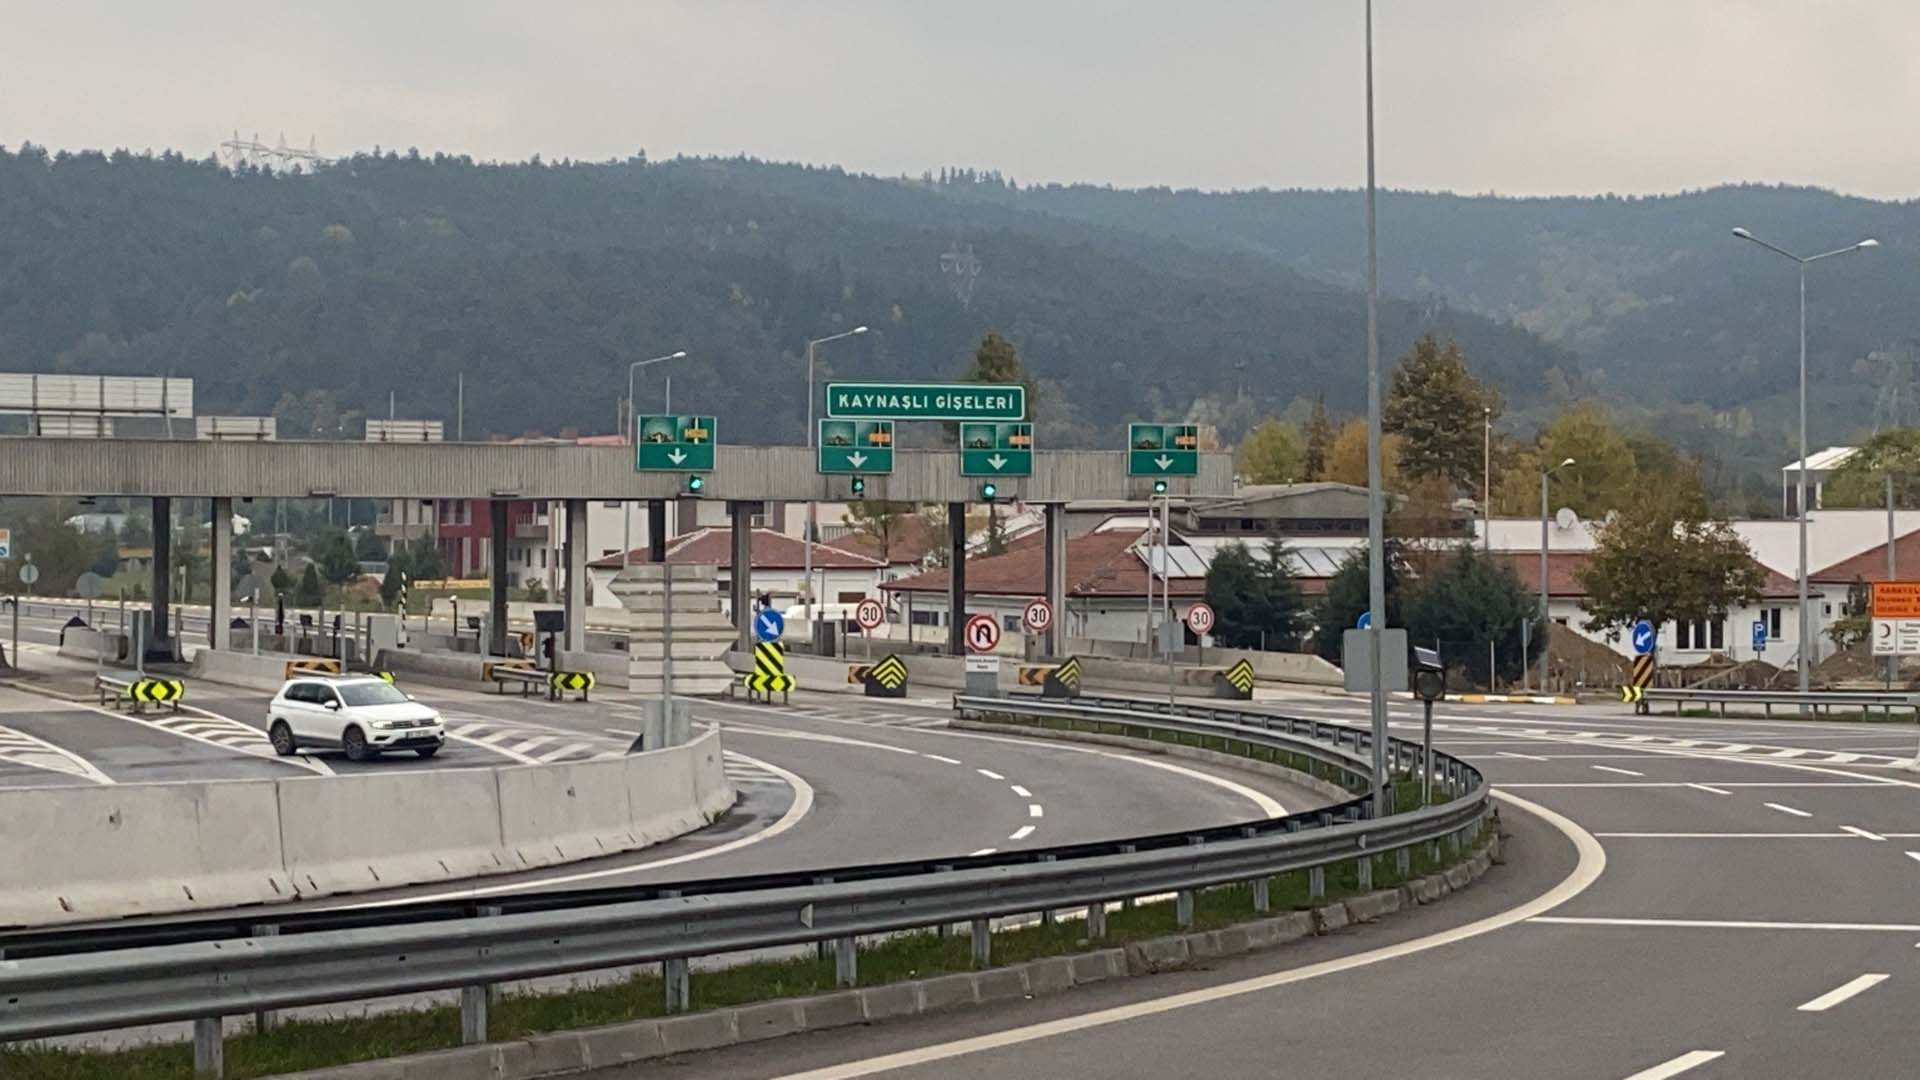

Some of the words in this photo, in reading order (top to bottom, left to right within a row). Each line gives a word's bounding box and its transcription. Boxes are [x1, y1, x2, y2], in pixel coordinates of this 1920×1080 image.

[839, 394, 928, 410] KAYNAŞLI
[935, 393, 1013, 411] GİŞELERİ
[862, 606, 878, 622] 30
[1030, 607, 1046, 623] 30
[1192, 611, 1209, 625] 30
[1754, 623, 1764, 638] P
